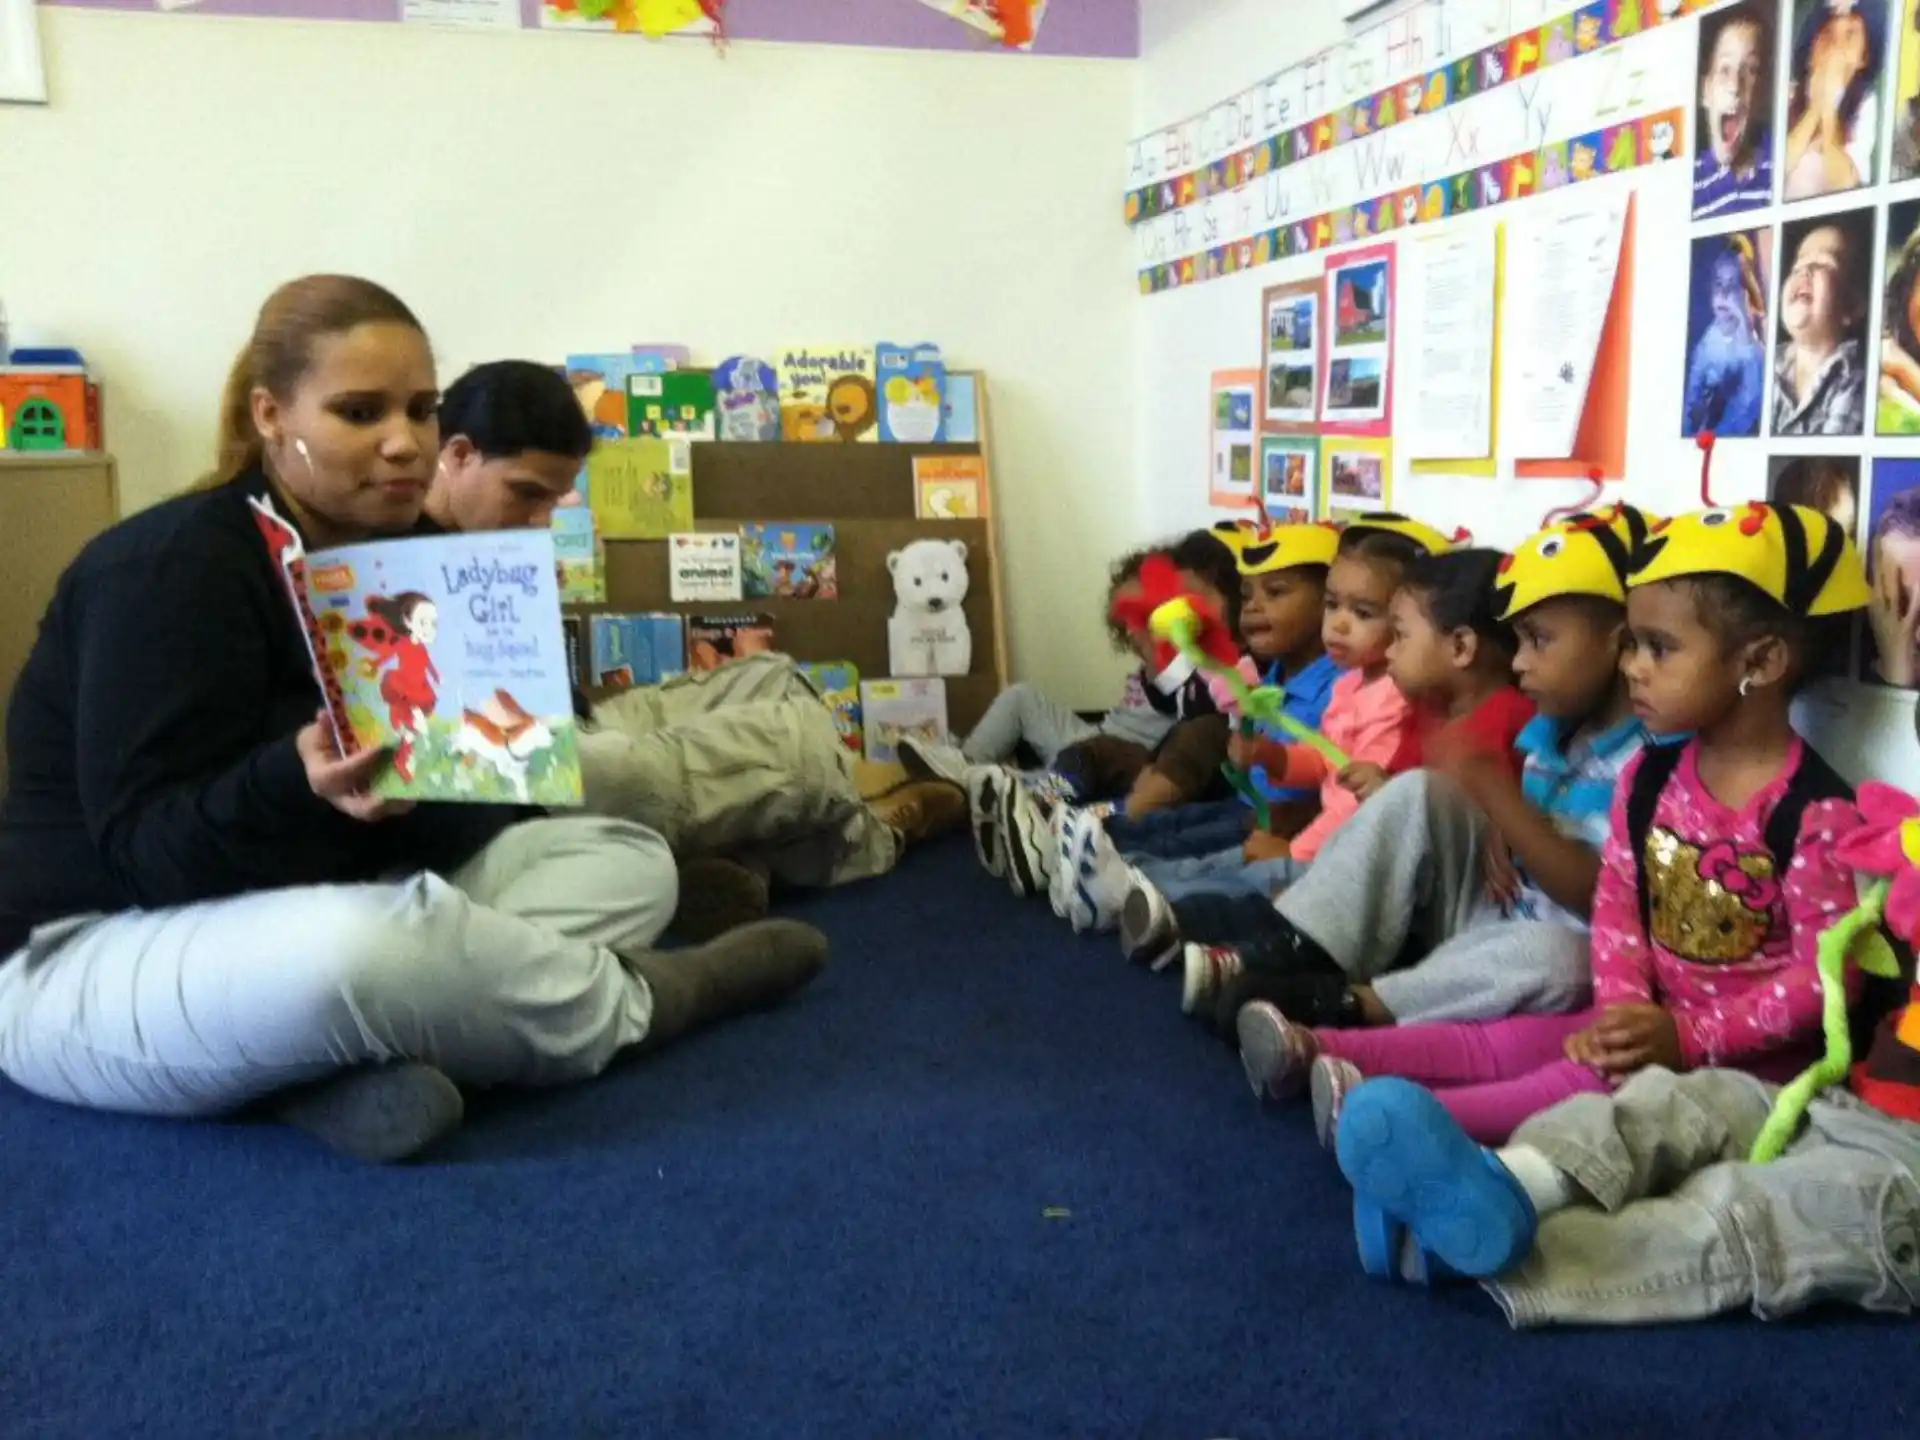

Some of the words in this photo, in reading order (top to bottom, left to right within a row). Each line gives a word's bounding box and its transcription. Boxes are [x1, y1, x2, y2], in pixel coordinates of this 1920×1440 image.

[1353, 132, 1405, 191] Ww
[1445, 109, 1478, 166] Xx
[1515, 77, 1552, 150] Yy
[784, 349, 866, 372] Adorable
[440, 556, 539, 597] Ladybug
[679, 564, 733, 579] animal
[469, 593, 521, 624] Girl
